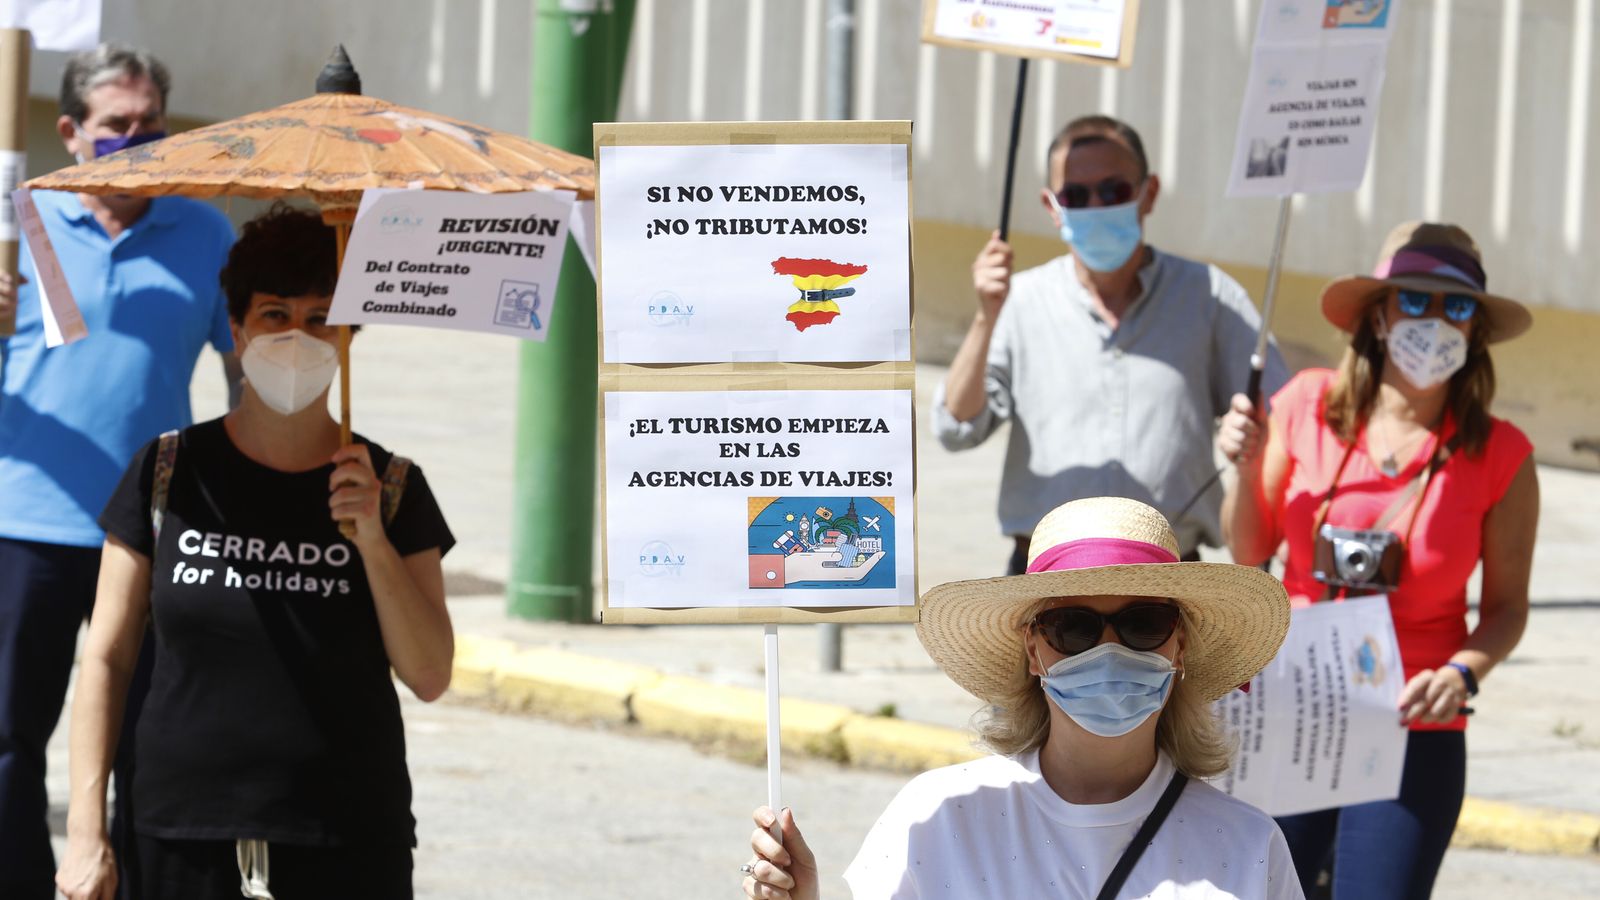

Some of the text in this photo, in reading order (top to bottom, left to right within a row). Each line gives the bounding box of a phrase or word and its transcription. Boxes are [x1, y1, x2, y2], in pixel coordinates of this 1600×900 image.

[647, 185, 866, 205] SI NO VENDEMOS,
[438, 213, 560, 236] REVISIÓN
[646, 218, 867, 239] ¡NO TRIBUTAMOS!
[437, 241, 545, 259] ¡URGENTE!
[365, 261, 470, 275] Del Contrato
[375, 281, 449, 296] de Viajes
[362, 301, 457, 317] Combinado
[629, 417, 890, 438] ¡EL TURISMO EMPIEZA
[719, 443, 800, 458] EN LAS
[628, 470, 893, 487] AGENCIAS DE VIAJES!
[178, 529, 350, 566] CERRADO
[172, 562, 350, 597] for holidays
